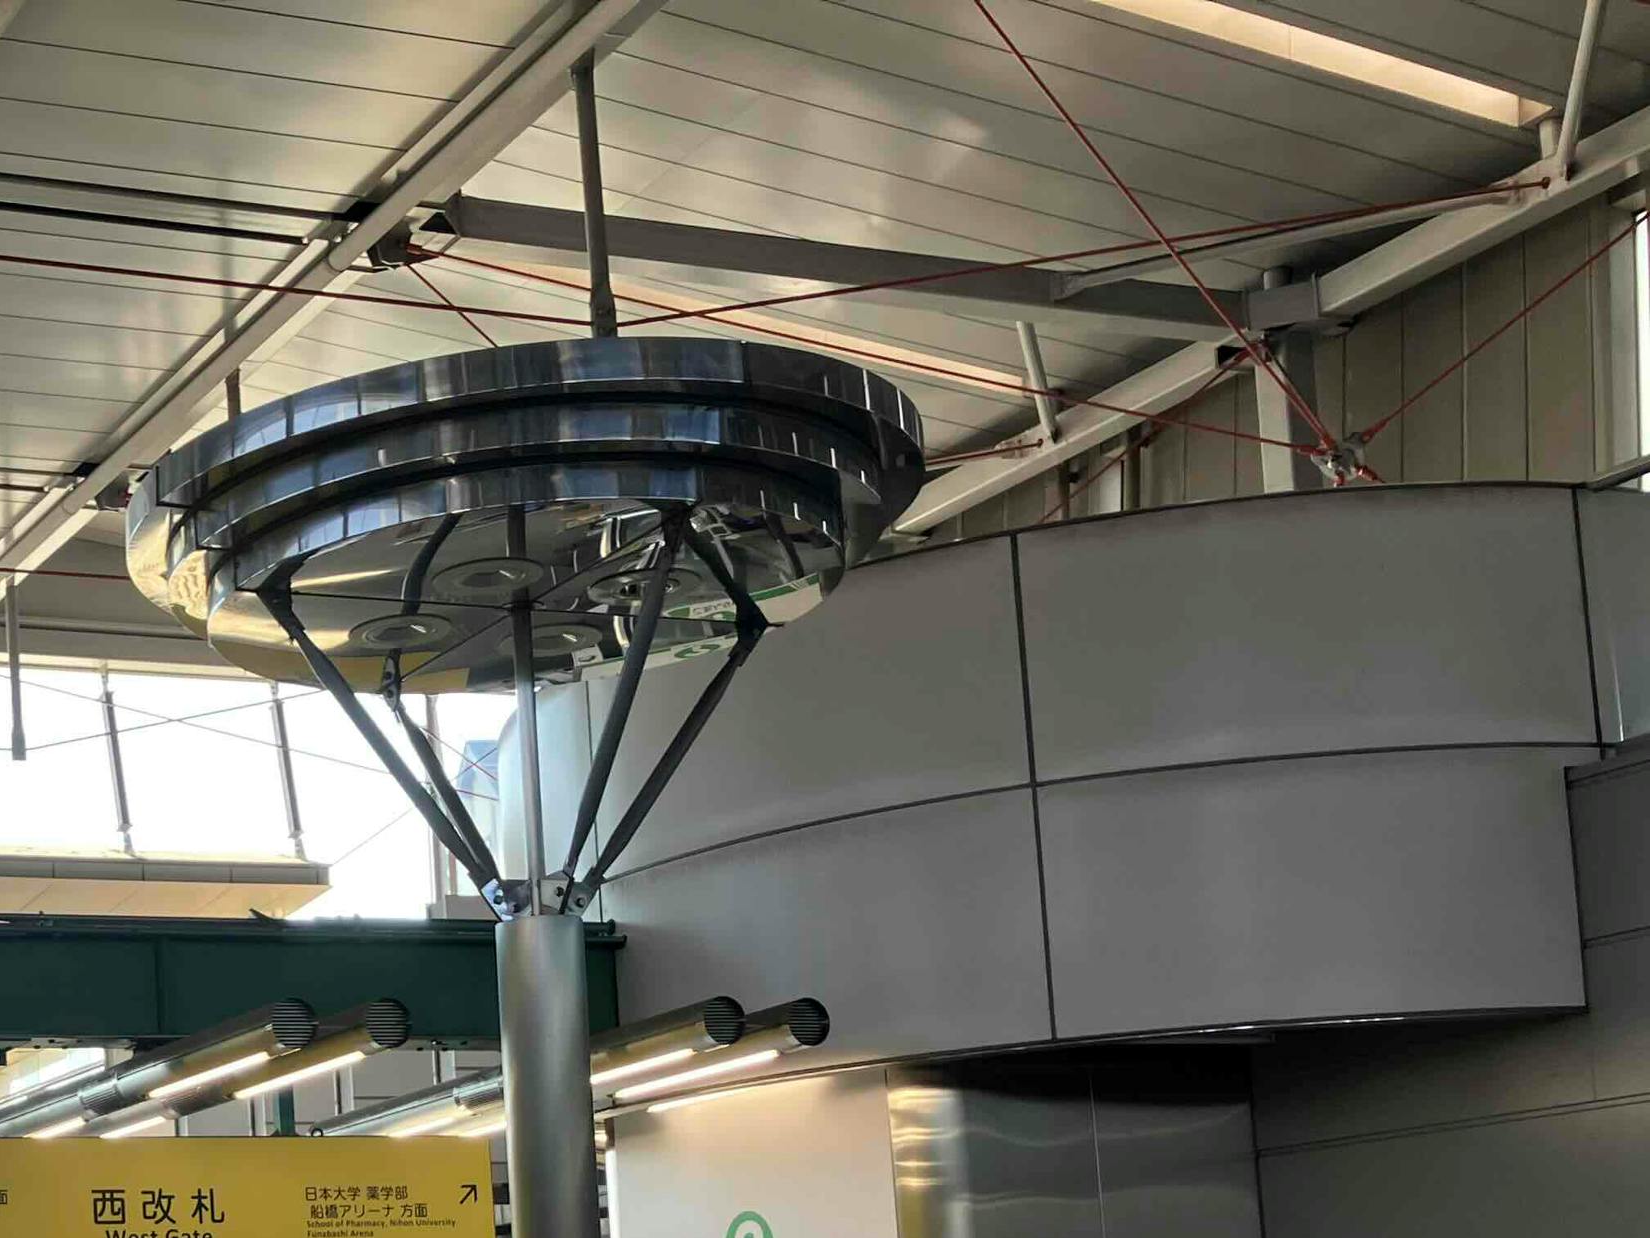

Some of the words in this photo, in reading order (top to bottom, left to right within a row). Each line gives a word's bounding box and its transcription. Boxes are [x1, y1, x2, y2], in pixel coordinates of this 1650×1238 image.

[305, 1187, 361, 1201] 日本大学
[366, 1186, 408, 1201] 薬学部
[91, 1188, 225, 1225] 西改札
[310, 1204, 394, 1219] 船橋アリーナ
[400, 1203, 428, 1218] 方面
[307, 1220, 333, 1228] School
[390, 1219, 413, 1227] Nihon
[416, 1218, 455, 1228] University
[307, 1230, 347, 1238] Funabashi
[351, 1229, 374, 1238] Arena
